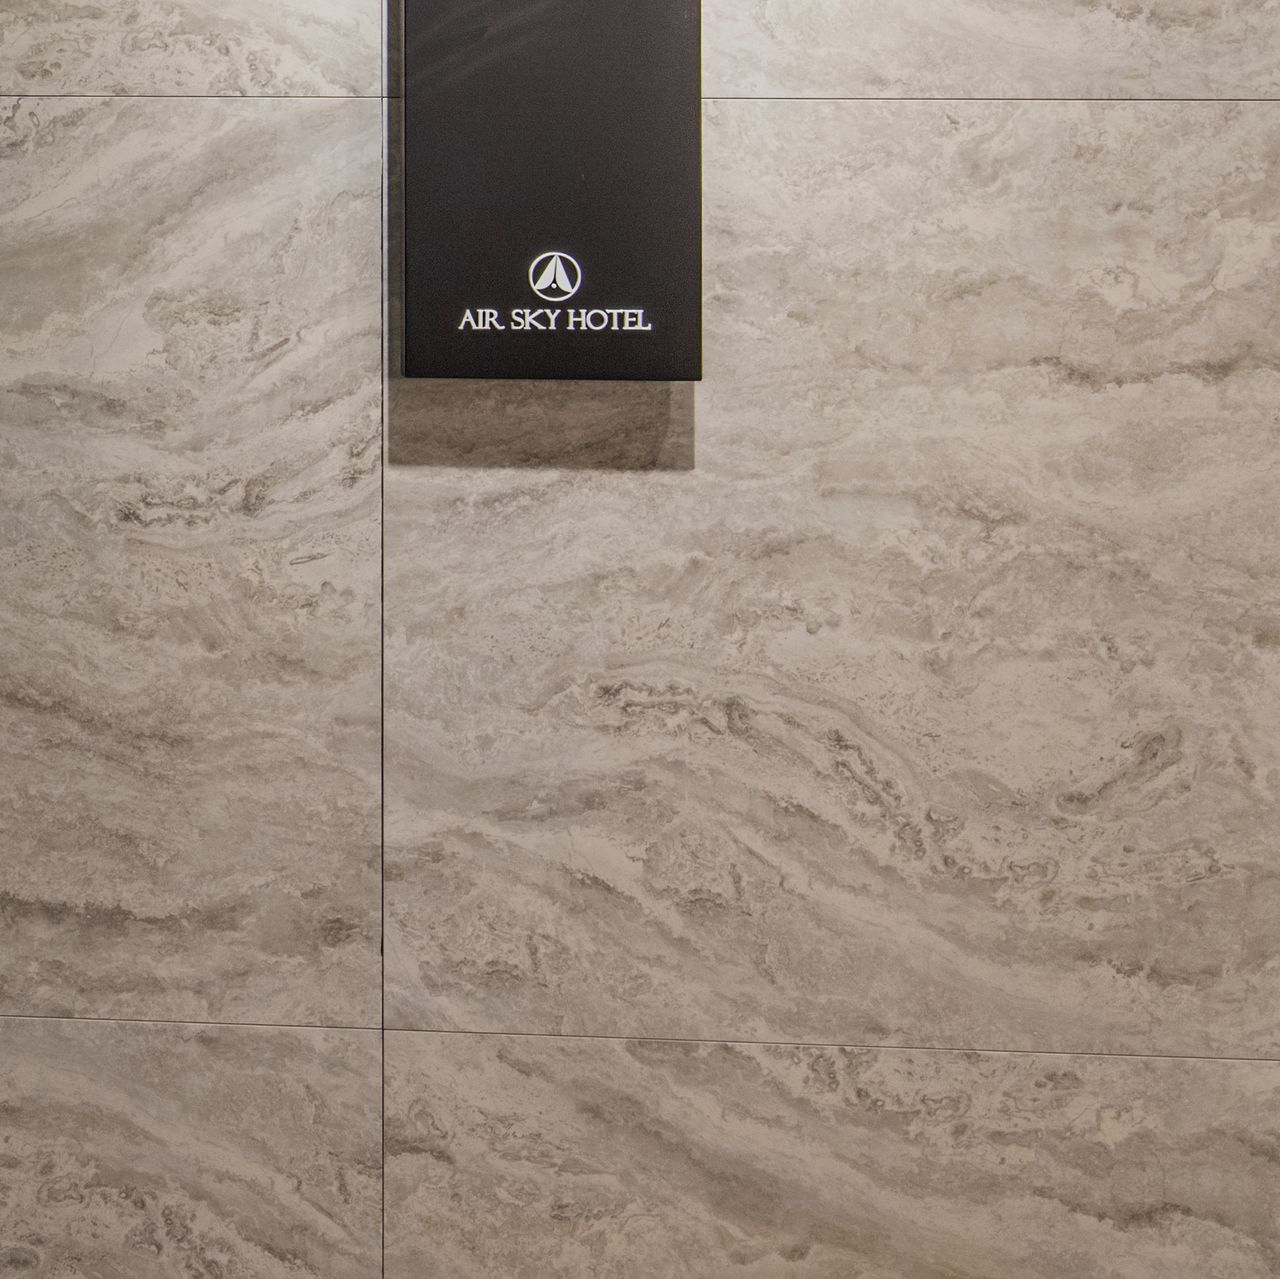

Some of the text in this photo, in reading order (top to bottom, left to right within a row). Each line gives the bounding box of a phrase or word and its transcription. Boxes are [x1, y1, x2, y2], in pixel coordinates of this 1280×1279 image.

[458, 308, 652, 331] AIR SKY HOTEL
